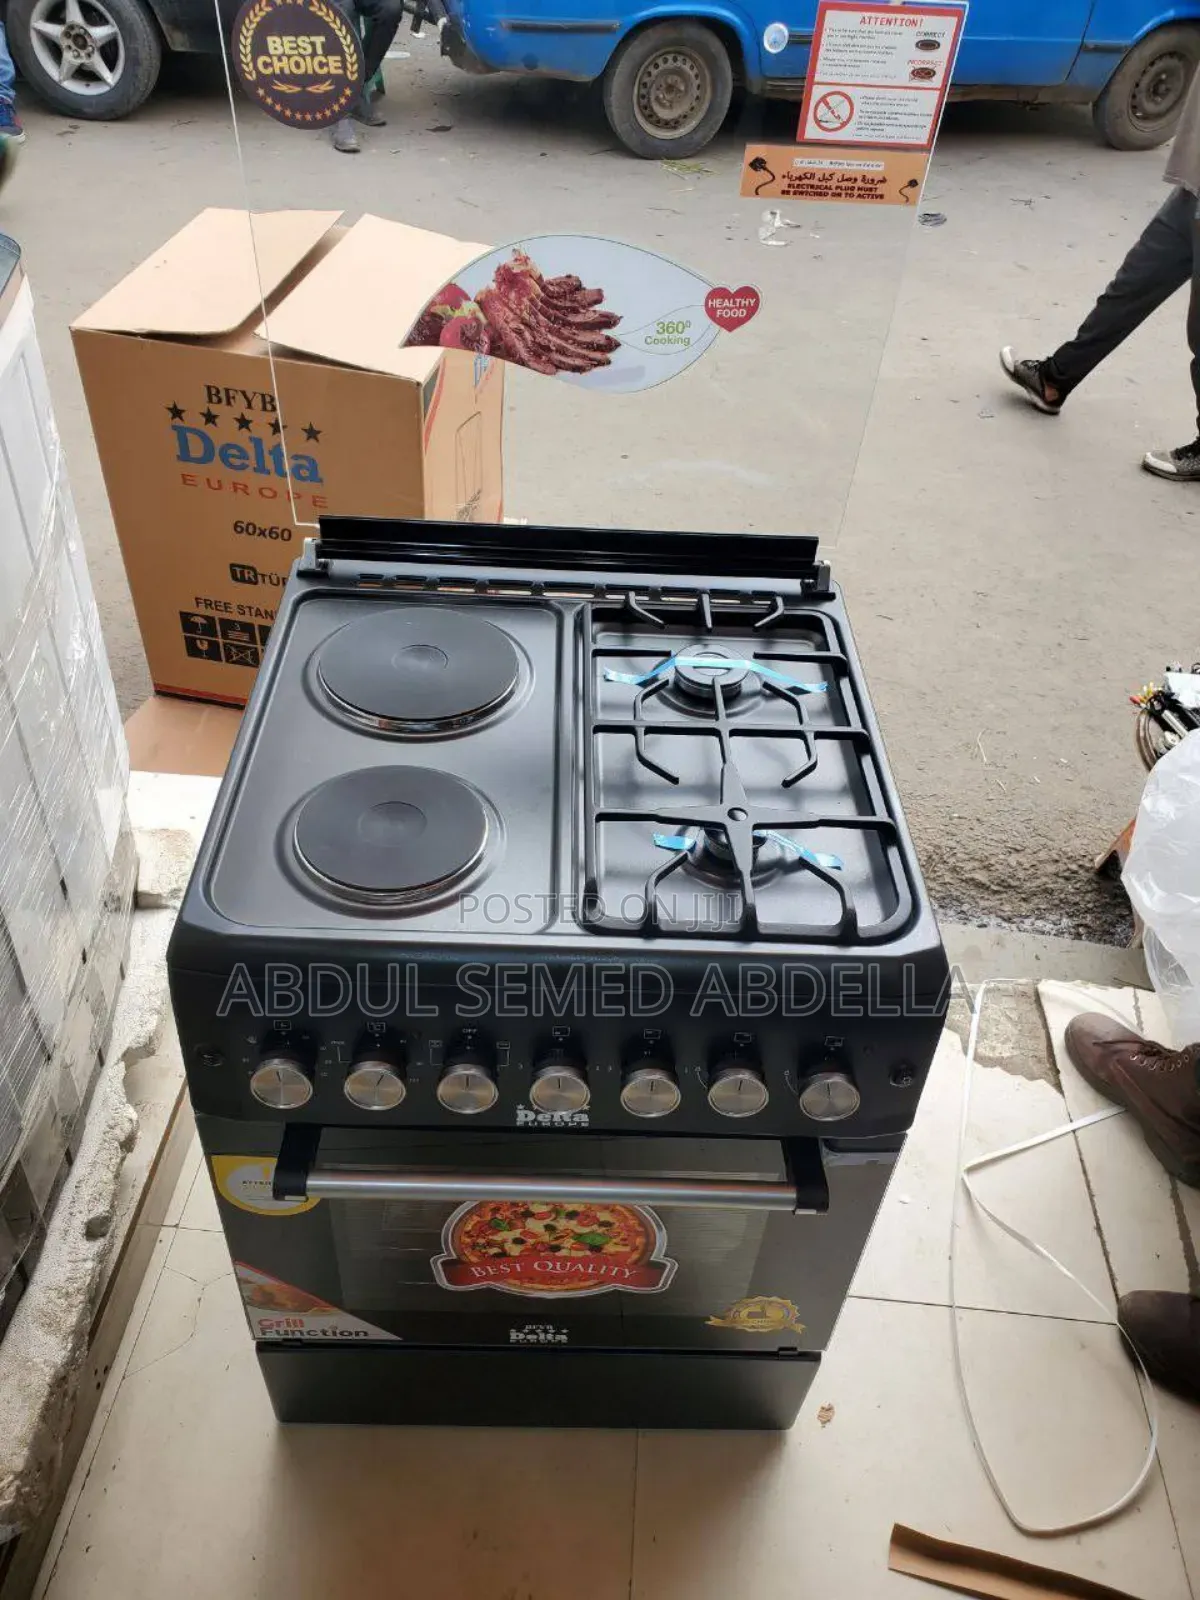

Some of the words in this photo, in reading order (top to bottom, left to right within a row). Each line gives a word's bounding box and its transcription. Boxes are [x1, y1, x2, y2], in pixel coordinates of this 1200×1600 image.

[860, 16, 924, 27] ATTENTION!
[266, 36, 326, 55] BEST
[257, 56, 343, 75] CHOICE
[837, 174, 859, 184] وصل
[787, 183, 833, 191] ELECTRICAL
[708, 298, 757, 309] HEALTHY
[716, 308, 747, 318] FOOD
[644, 336, 691, 346] Cooking
[204, 385, 278, 412] BFYB
[171, 424, 324, 484] Delta
[181, 473, 329, 509] EUROPE
[233, 520, 292, 541] 60x60
[195, 596, 232, 614] FREE
[470, 1262, 524, 1278] BEST
[533, 1260, 638, 1279] QUALITY
[258, 1318, 304, 1329] Grill
[260, 1327, 369, 1338] Function
